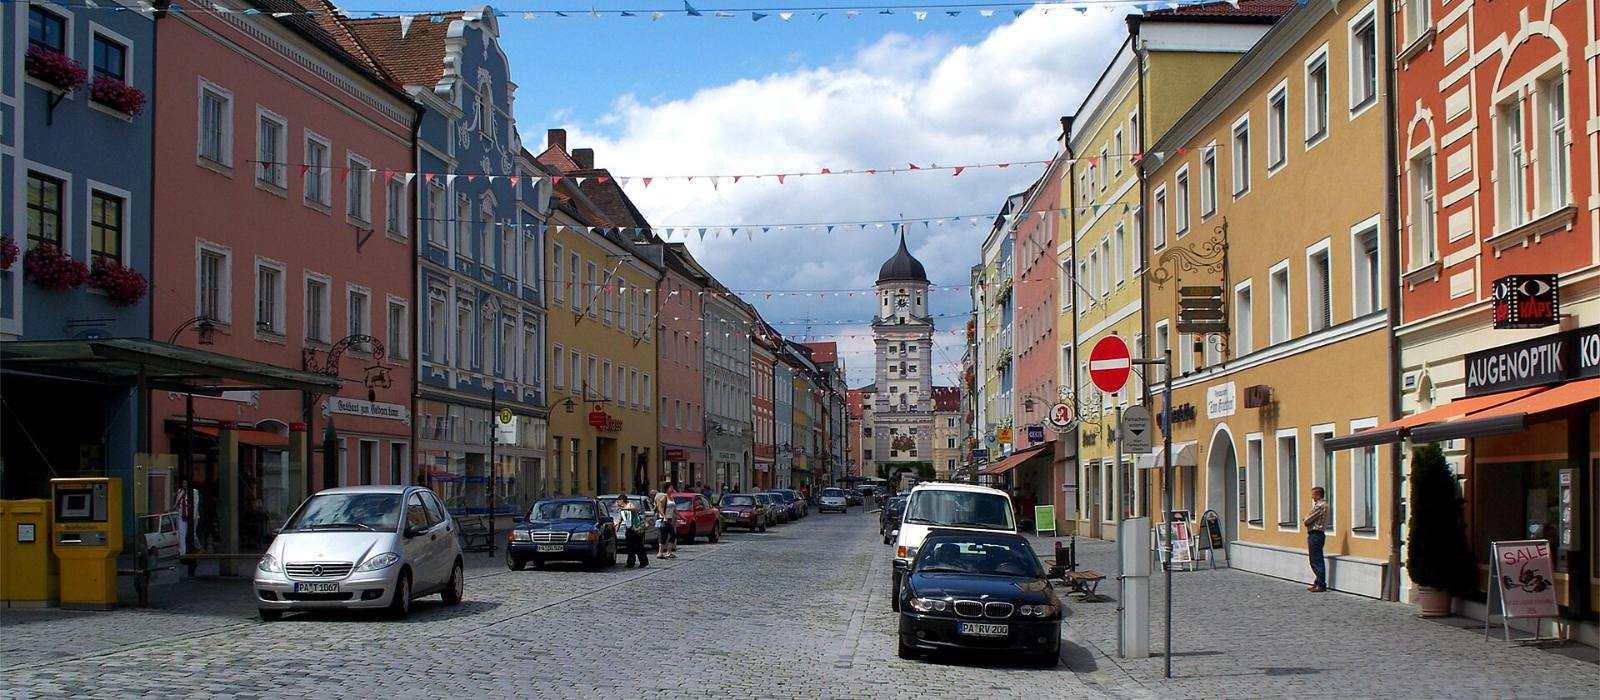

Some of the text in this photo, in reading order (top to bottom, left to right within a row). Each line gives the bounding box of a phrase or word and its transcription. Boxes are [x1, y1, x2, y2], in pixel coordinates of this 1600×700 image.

[1520, 295, 1552, 319] KAPS
[1468, 333, 1600, 387] AUGENOPTIK KO
[1504, 544, 1548, 565] SALE
[299, 583, 309, 591] PA
[963, 624, 974, 632] PA
[979, 625, 991, 633] RV
